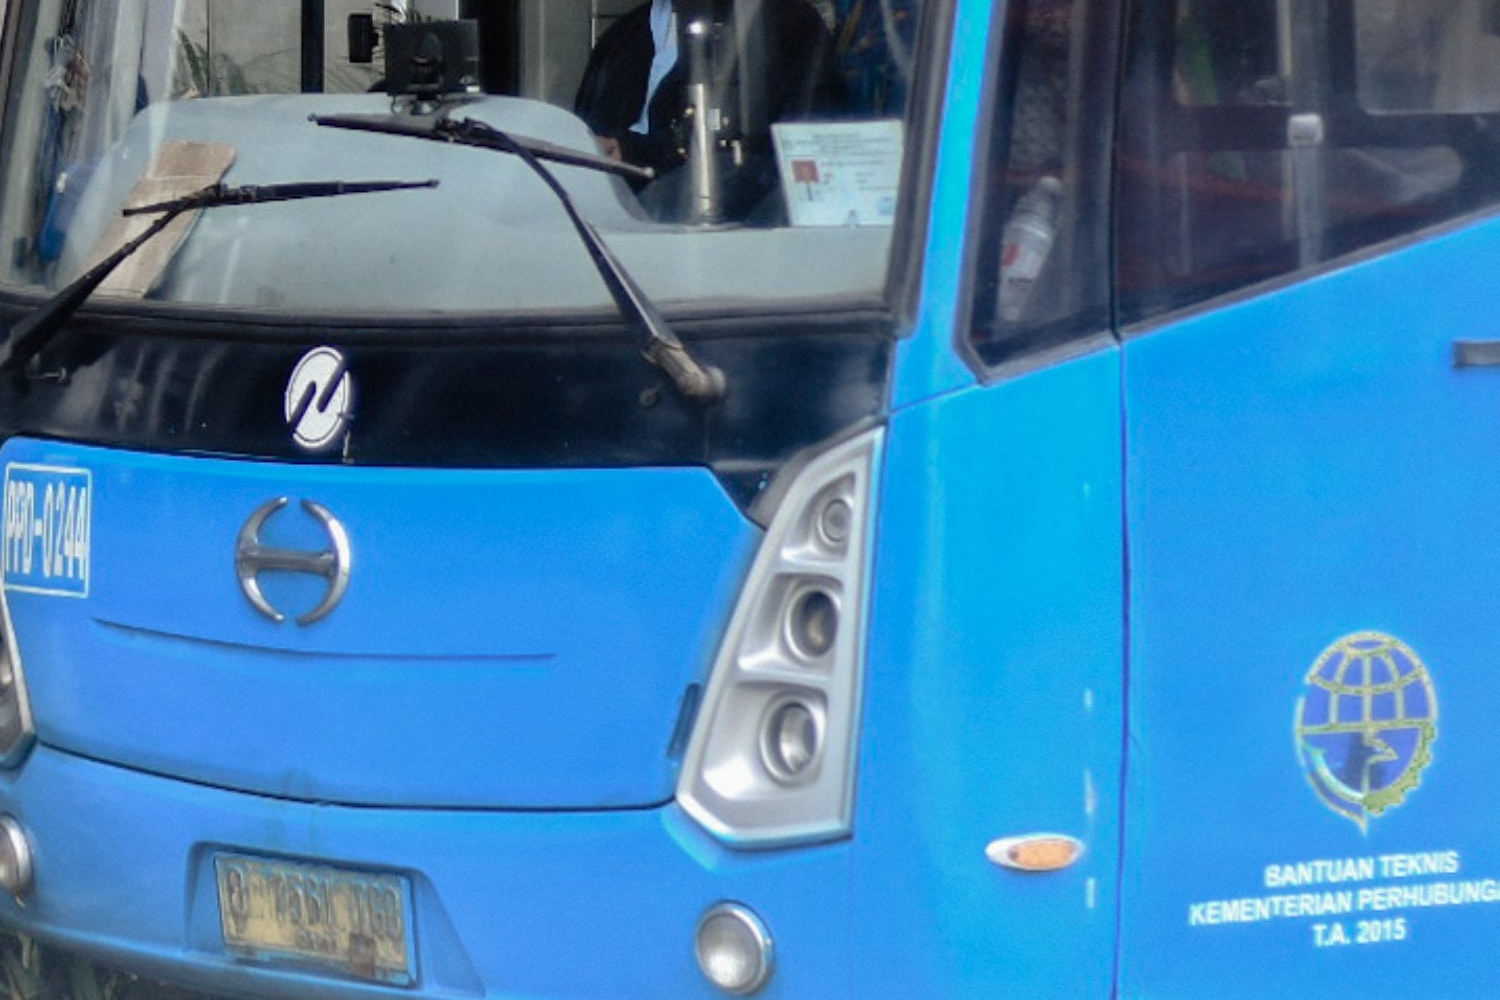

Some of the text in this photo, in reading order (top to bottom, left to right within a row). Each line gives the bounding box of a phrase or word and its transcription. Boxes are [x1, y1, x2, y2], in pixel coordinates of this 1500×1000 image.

[6, 480, 87, 580] PPD-0244
[1264, 850, 1460, 888] BANTUAN TEKNIS
[1189, 879, 1500, 926] KEMENTERIAN PERHUBUNG
[1312, 918, 1408, 947] T.A. 2015
